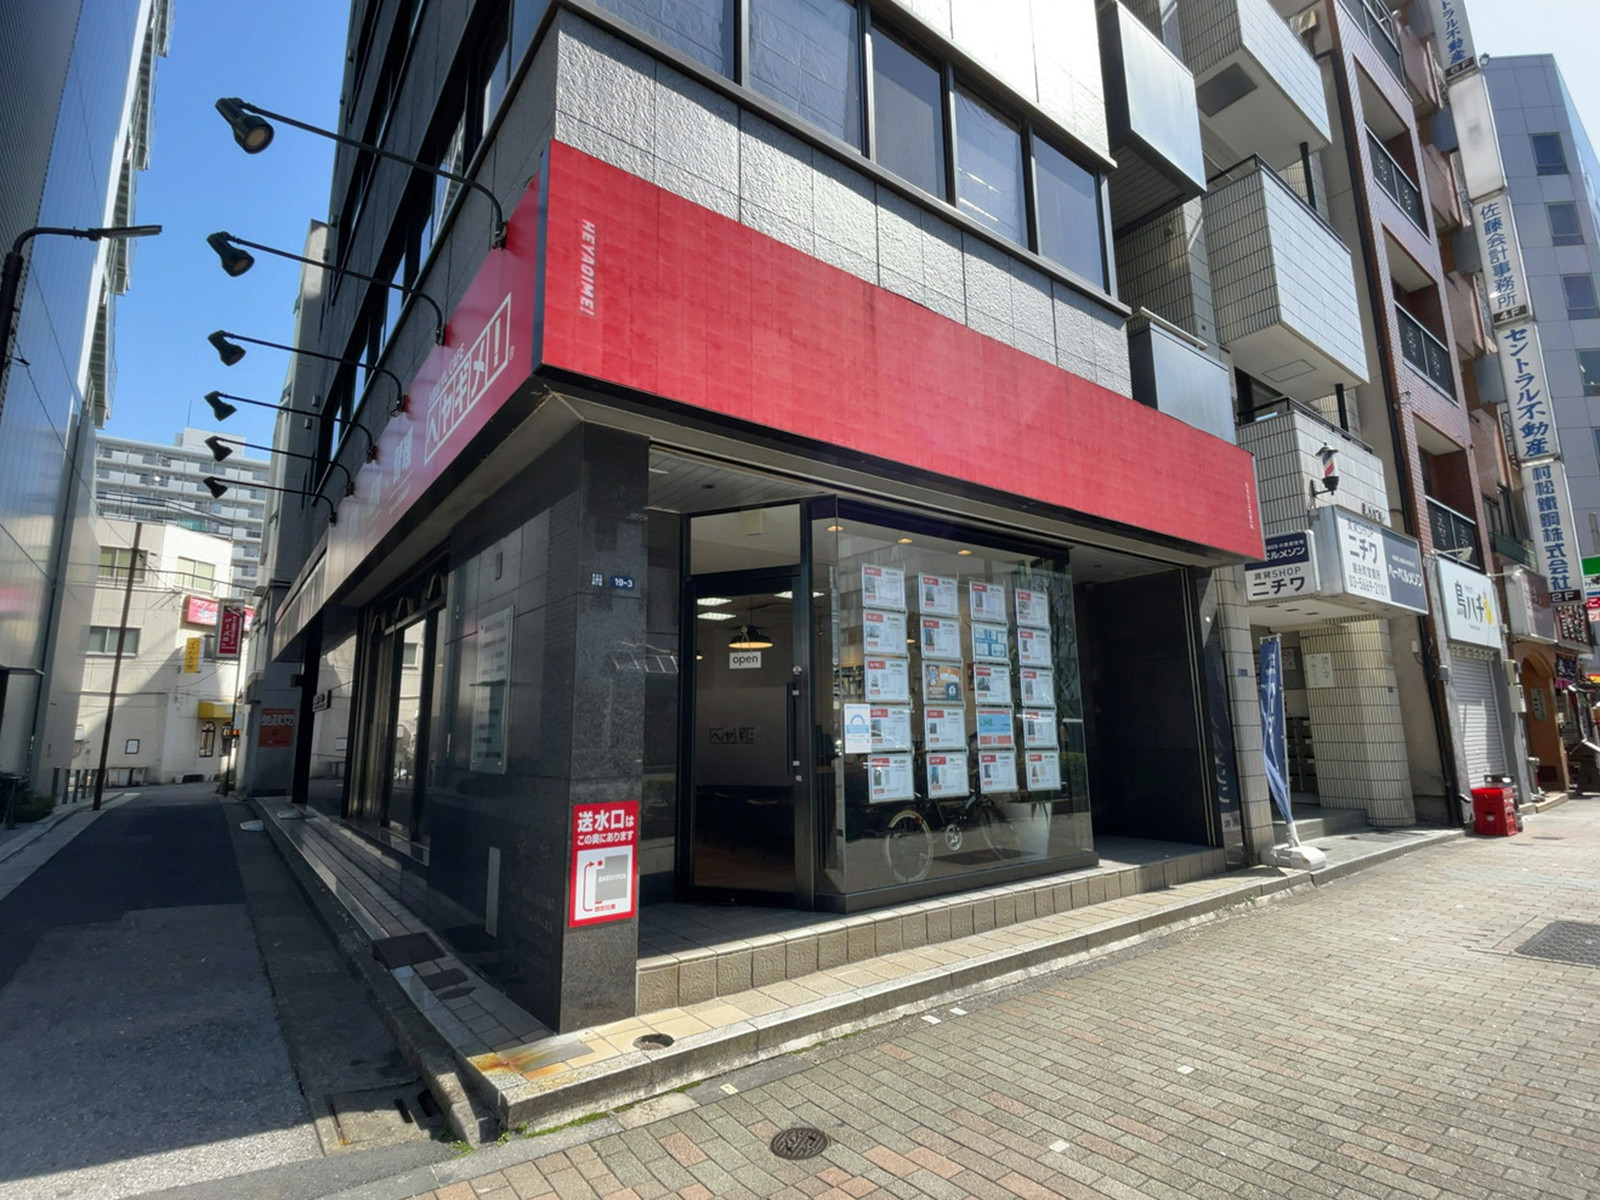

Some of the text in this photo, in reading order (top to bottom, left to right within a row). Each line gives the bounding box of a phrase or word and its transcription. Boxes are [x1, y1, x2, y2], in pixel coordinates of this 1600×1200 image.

[1480, 202, 1517, 310] 佐藤会計事務所
[1500, 309, 1521, 321] 4F
[1504, 328, 1549, 457] セントラル不動産
[1348, 534, 1378, 565] ニチワ
[614, 577, 633, 588] 19-3
[1253, 576, 1305, 597] ニチワ
[1551, 590, 1575, 602] 2F
[732, 653, 759, 666] open
[577, 809, 635, 833] 送水口は
[577, 830, 634, 846] この奥にあります
